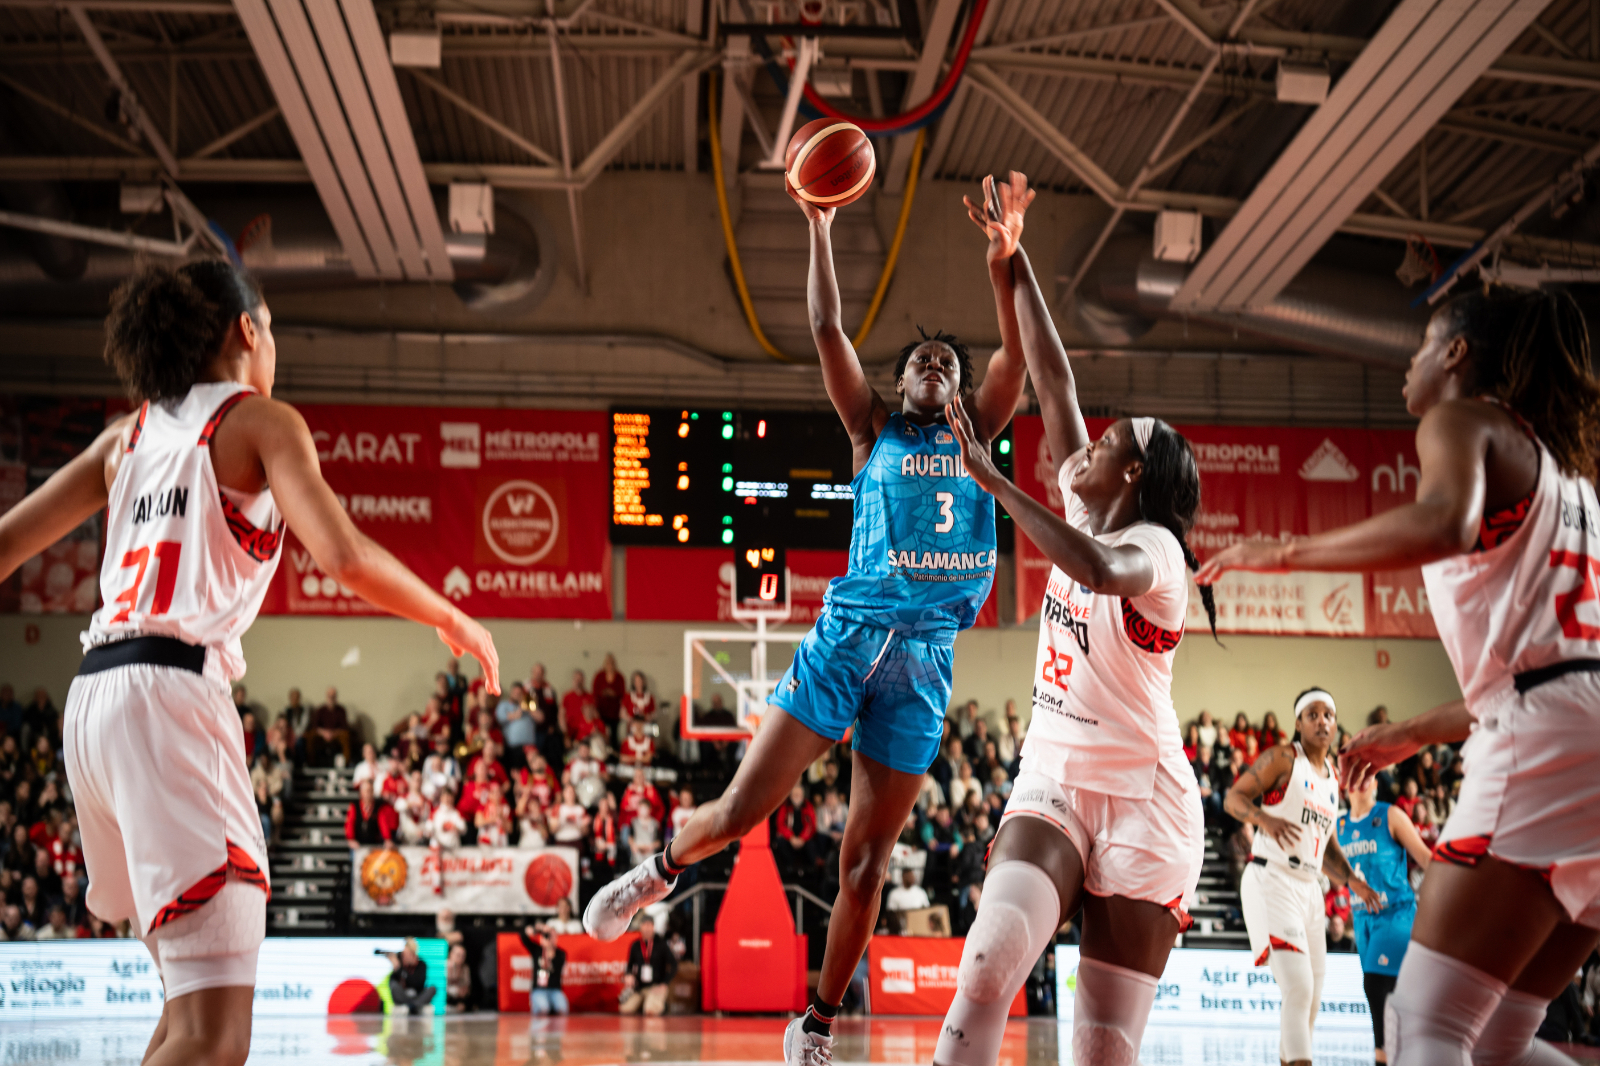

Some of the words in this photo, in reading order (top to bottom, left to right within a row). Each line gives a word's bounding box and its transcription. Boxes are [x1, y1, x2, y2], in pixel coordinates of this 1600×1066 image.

[312, 430, 421, 464] CARAT
[485, 428, 599, 449] MÉTROPOLE
[1191, 443, 1280, 462] TROPOLE
[935, 492, 955, 533] 3
[887, 549, 996, 570] SALAMANCA
[476, 570, 602, 592] CATHELAIN
[1235, 603, 1305, 619] FRANCE
[1043, 645, 1073, 692] 22
[1376, 650, 1390, 669] D
[1201, 966, 1240, 988] Agir
[1201, 992, 1243, 1010] bien
